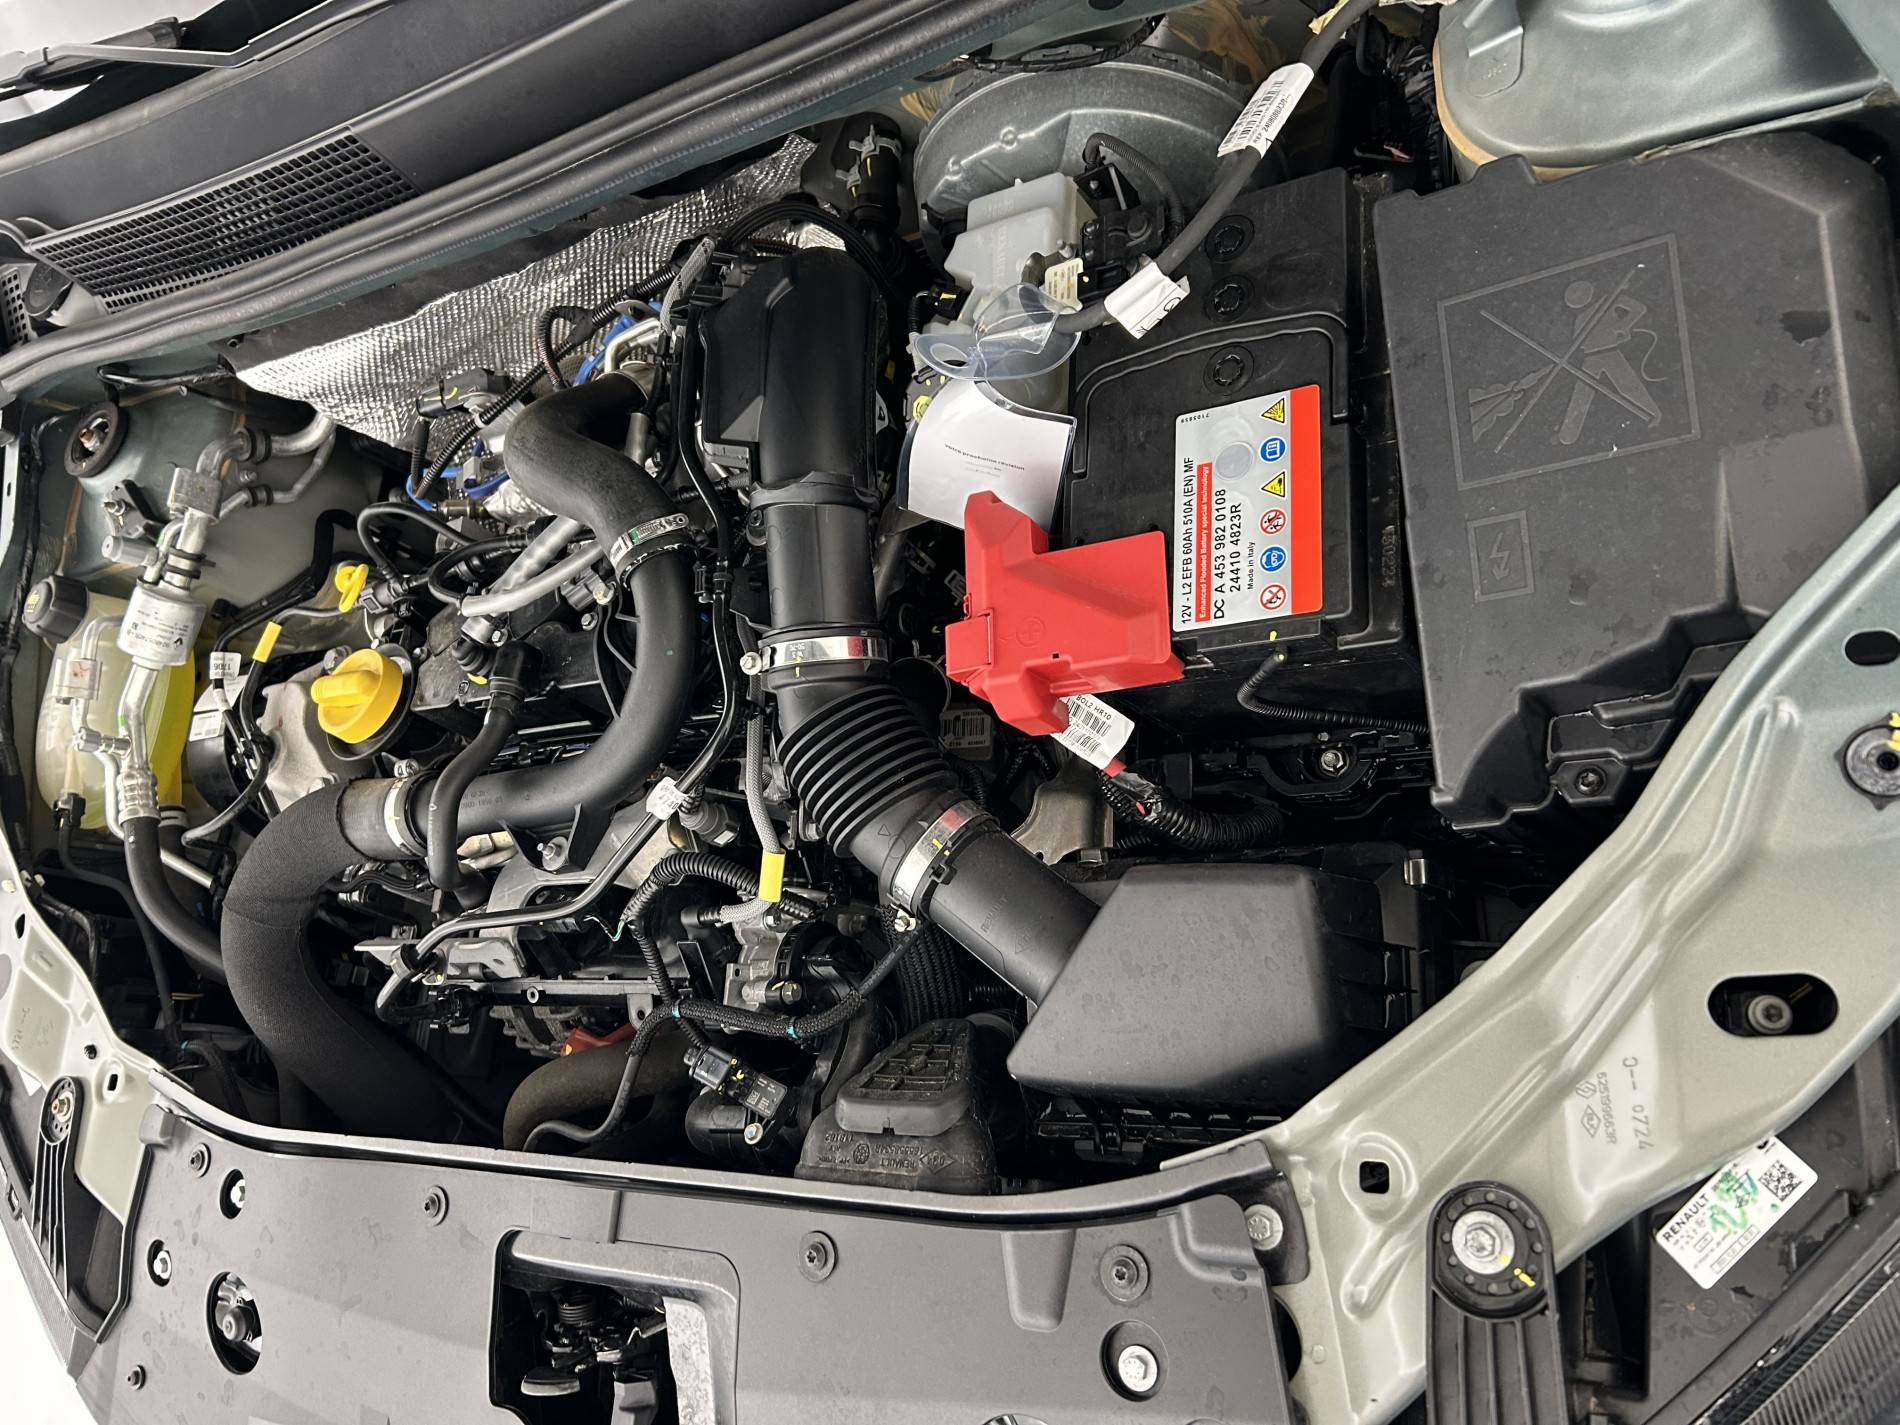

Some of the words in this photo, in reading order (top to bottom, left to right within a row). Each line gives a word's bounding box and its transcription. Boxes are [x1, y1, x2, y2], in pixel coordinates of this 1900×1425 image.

[1183, 457, 1194, 473] MF
[1183, 475, 1196, 497] (EN)
[1201, 466, 1210, 504] technology
[1183, 499, 1194, 525] 510A
[1201, 504, 1209, 529] special
[1214, 489, 1226, 521] 0108
[1229, 503, 1242, 546] 4823R
[1183, 528, 1193, 555] 60Ah
[1200, 529, 1209, 553] Battery
[1214, 526, 1226, 551] 982
[1247, 541, 1256, 558] Italy
[1182, 557, 1193, 580] EFB
[1200, 554, 1208, 583] Flooded
[1214, 555, 1226, 579] 453
[1230, 551, 1241, 592] 24410
[1182, 581, 1192, 595] L2
[1214, 583, 1226, 594] A
[1199, 584, 1207, 618] Enhanced
[1213, 599, 1225, 619] DC
[1181, 604, 1192, 624] 12V
[880, 1157, 915, 1169] RENAULT
[1662, 1193, 1710, 1242] RENAULT
